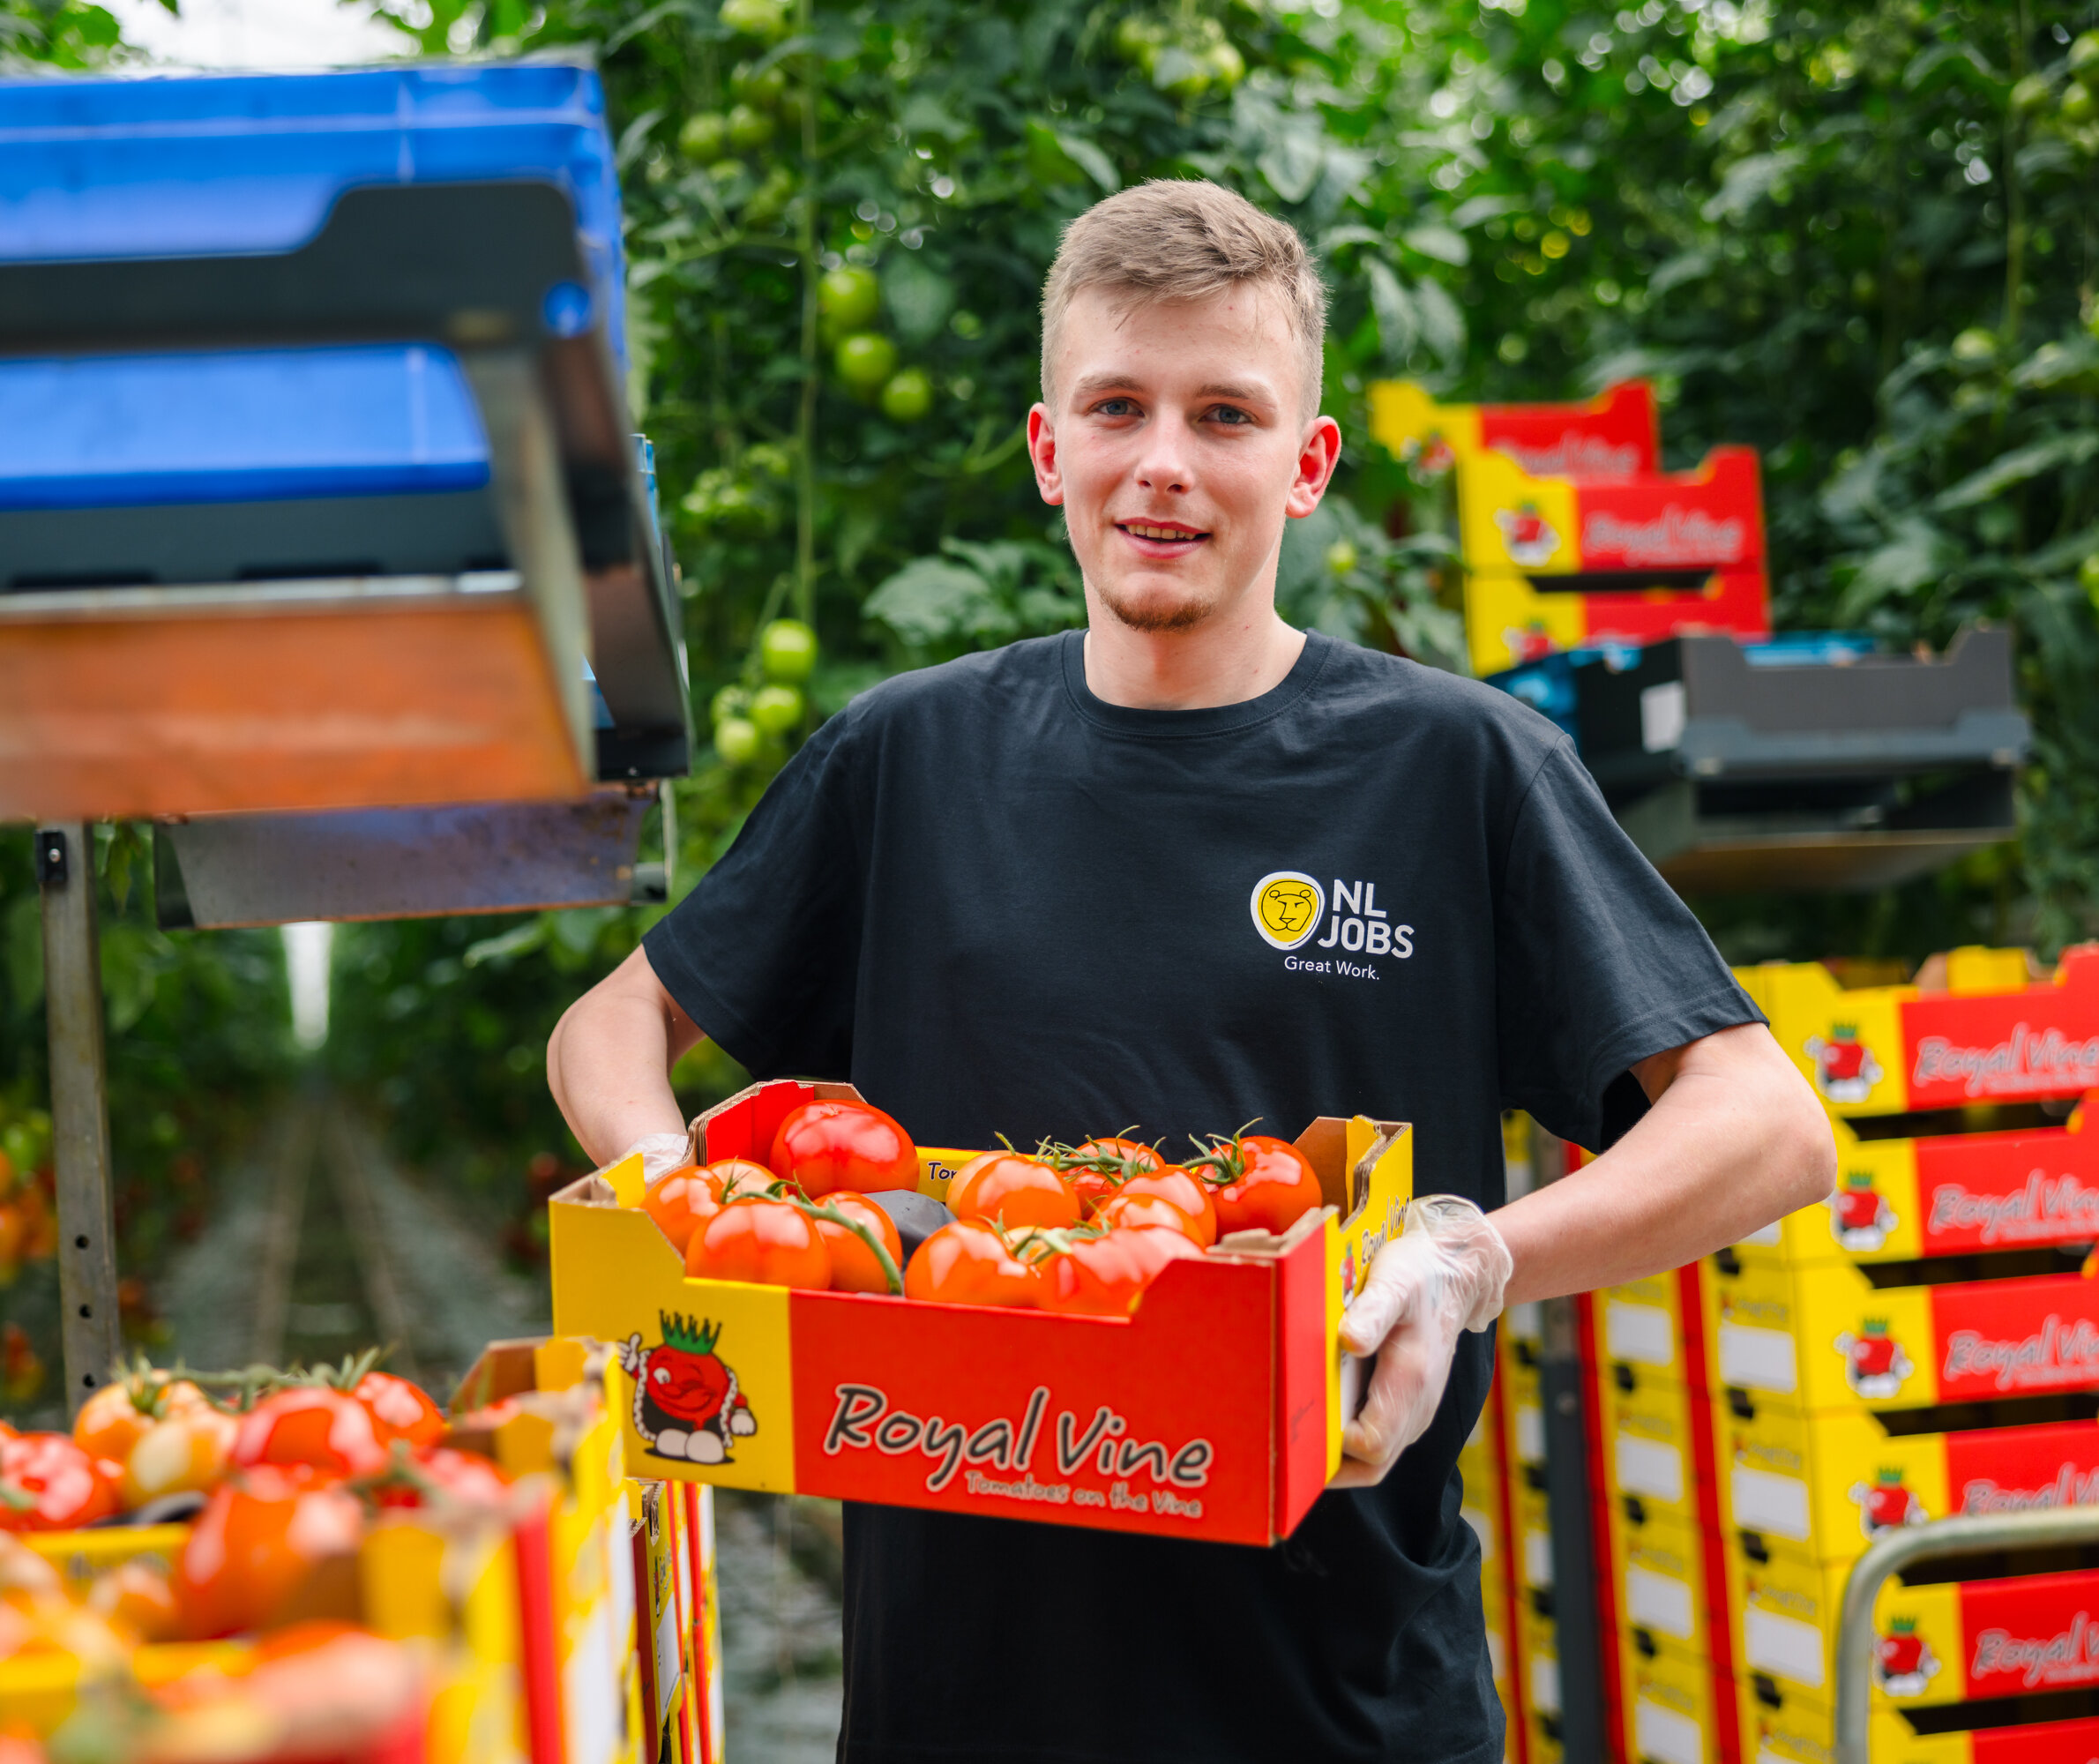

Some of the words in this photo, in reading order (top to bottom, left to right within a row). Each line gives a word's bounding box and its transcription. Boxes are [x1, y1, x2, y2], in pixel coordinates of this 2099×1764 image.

[1333, 879, 1386, 918] NL
[1284, 956, 1331, 973] Great
[1336, 960, 1379, 980] Work.
[1318, 916, 1414, 959] JOBS
[1913, 1021, 2028, 1097] Royal
[1927, 1168, 2045, 1245] Royal
[2041, 1173, 2099, 1220] Vin
[1943, 1313, 2061, 1392] Royal
[824, 1383, 1050, 1492] Royal
[1058, 1407, 1213, 1489] Vine
[965, 1469, 1071, 1505] Tomatoes
[1072, 1488, 1106, 1507] on
[1109, 1480, 1148, 1513] the
[1152, 1490, 1203, 1519] Vine
[1971, 1611, 2089, 1689] Royal
